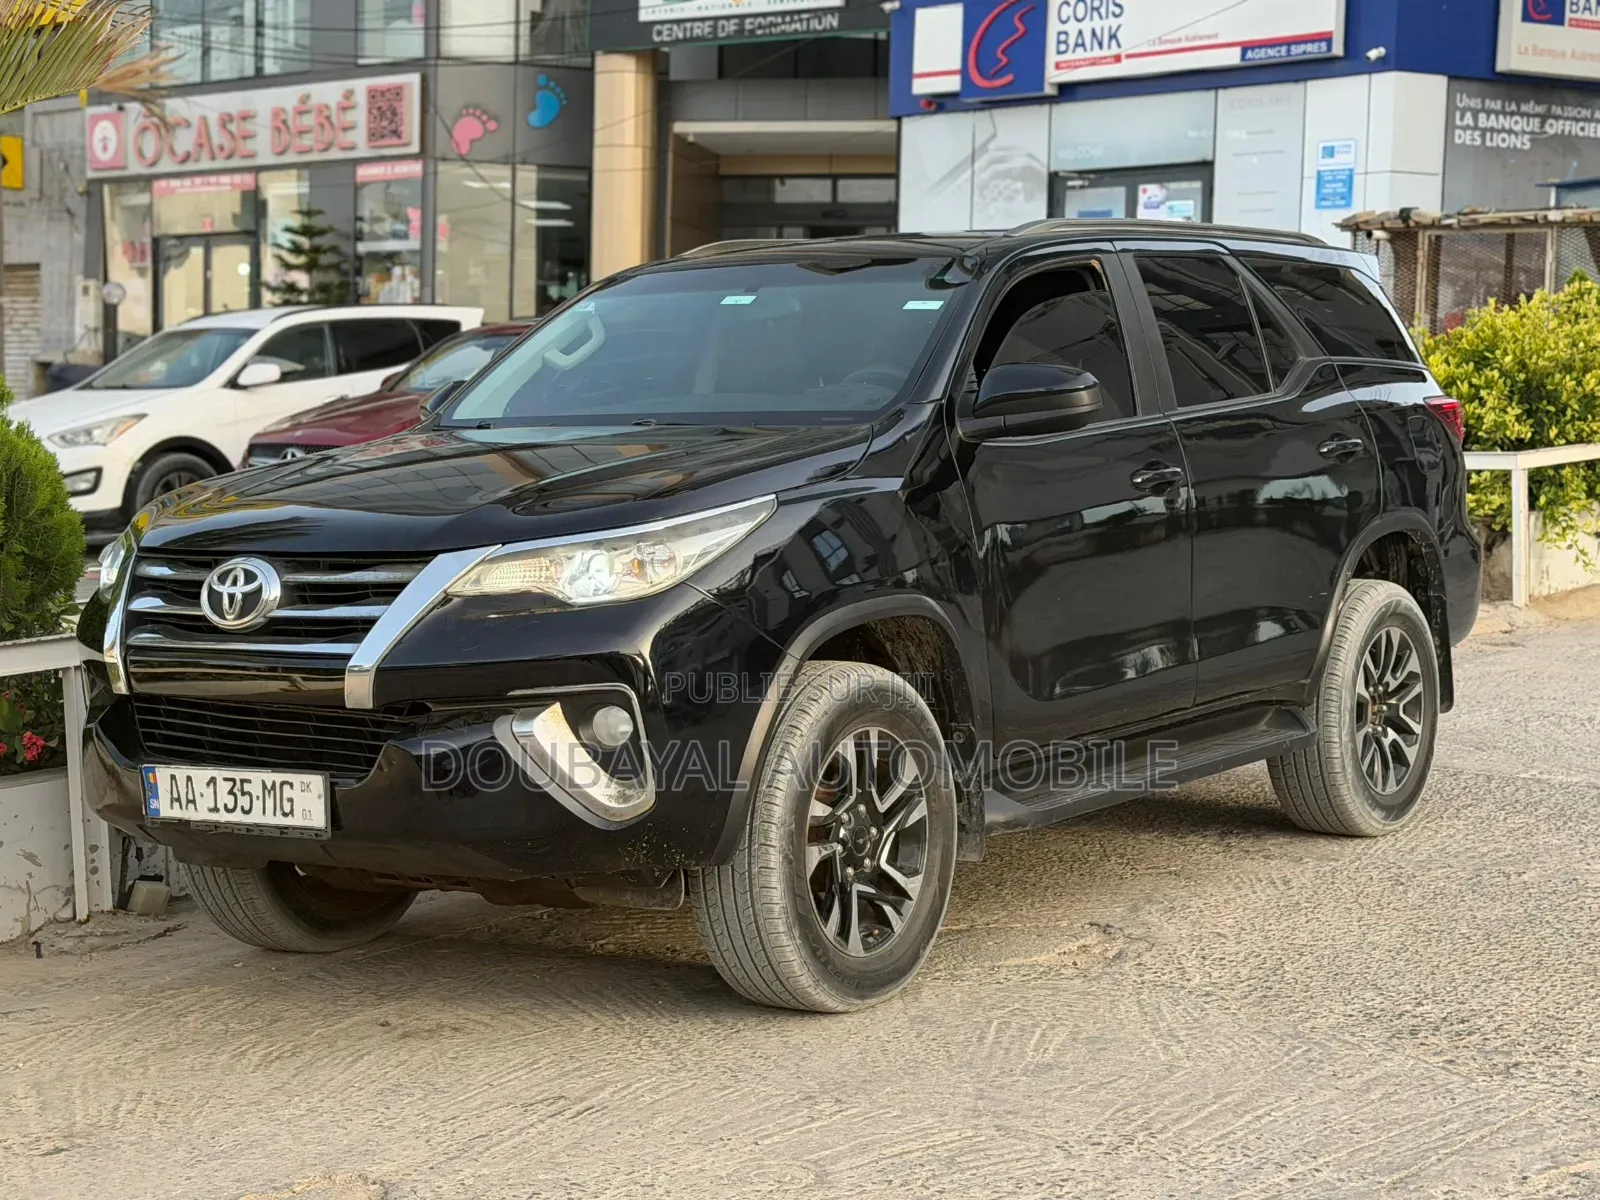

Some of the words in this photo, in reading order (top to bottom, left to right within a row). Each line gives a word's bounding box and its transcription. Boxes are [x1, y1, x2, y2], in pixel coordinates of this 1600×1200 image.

[1057, 0, 1124, 24] CORIS
[652, 20, 714, 43] CENTRE
[717, 18, 740, 38] DE
[744, 12, 840, 36] FORMATION
[1056, 25, 1123, 55] BANK
[1244, 45, 1288, 60] AGENCE
[1289, 40, 1328, 56] SIPRES
[1484, 98, 1503, 112] PAR
[1505, 100, 1518, 113] LA
[1551, 104, 1592, 120] PASSION
[270, 89, 357, 156] BÉBÉ
[1454, 110, 1475, 127] LA
[1478, 111, 1542, 133] BANQUE
[1454, 128, 1482, 147] DES
[1485, 130, 1532, 150] LIONS
[300, 781, 313, 794] DK
[150, 799, 160, 810] SN
